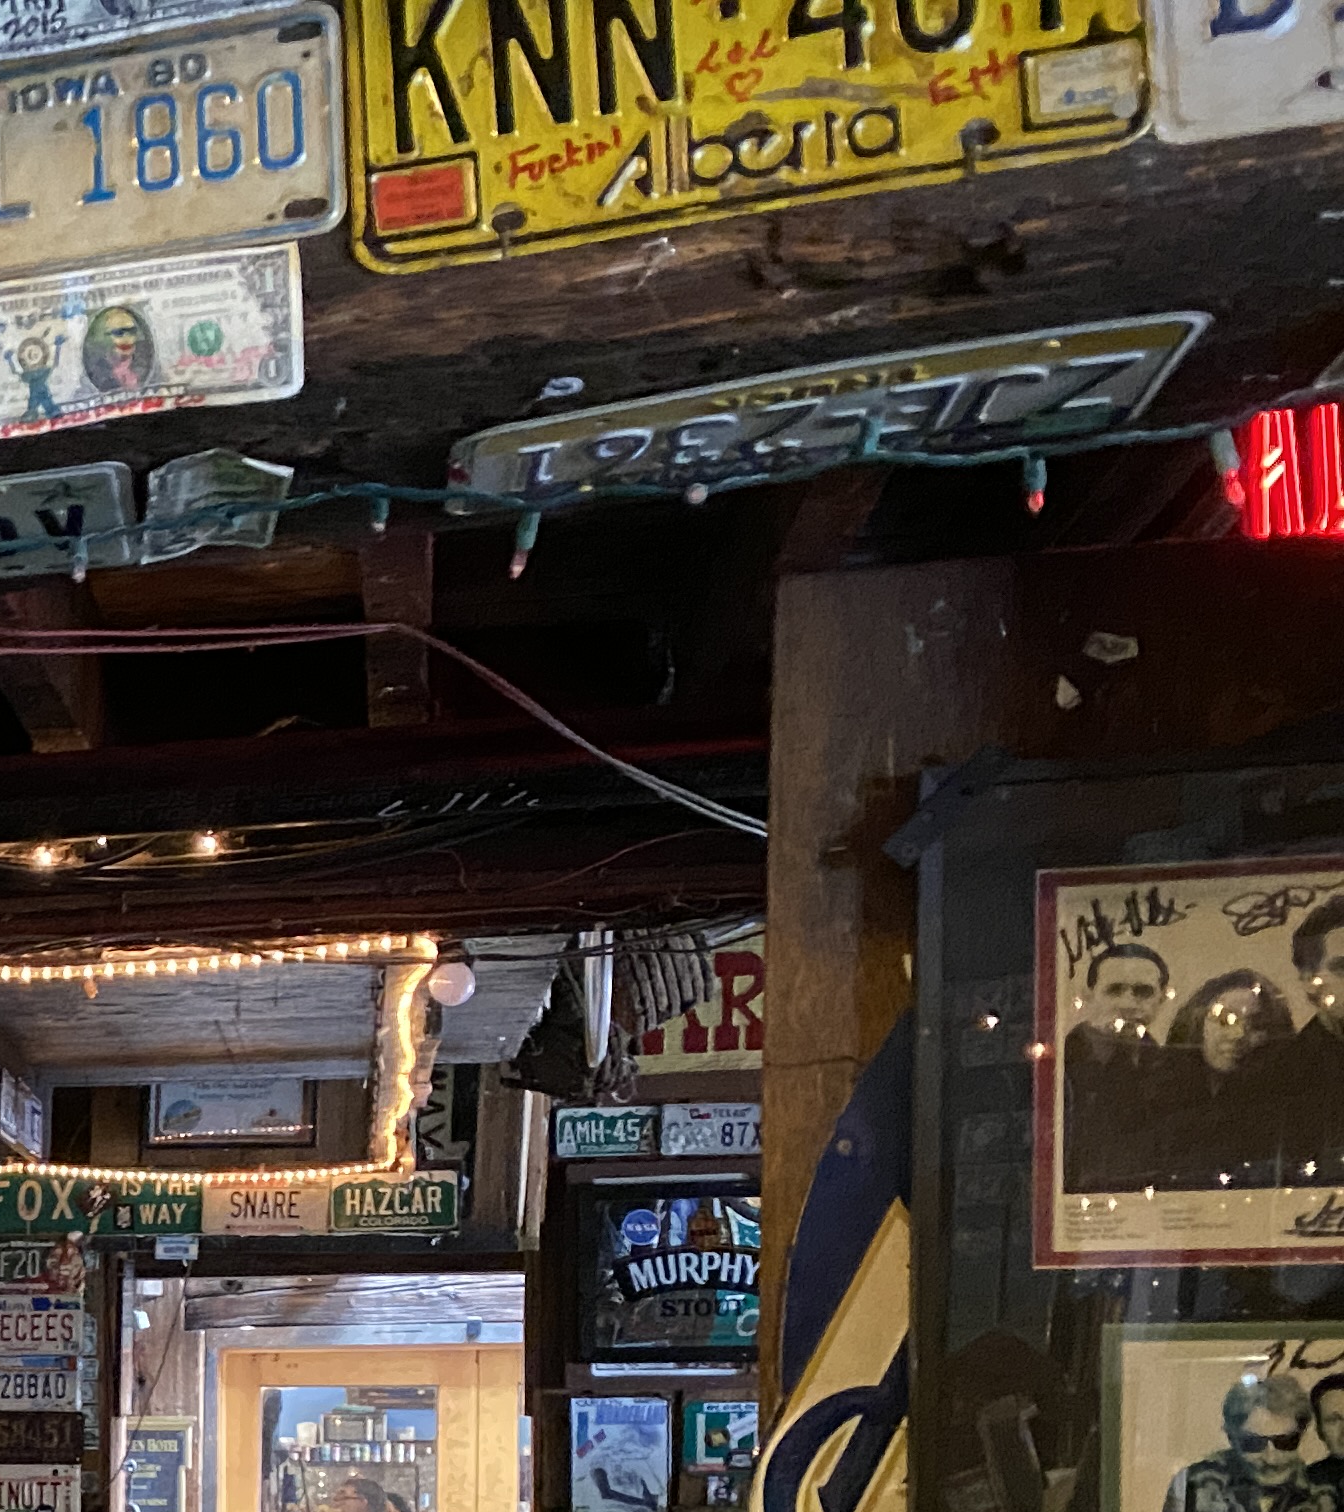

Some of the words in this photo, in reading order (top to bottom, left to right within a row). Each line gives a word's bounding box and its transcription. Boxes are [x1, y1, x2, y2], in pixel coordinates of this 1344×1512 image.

[8, 71, 120, 114] IOWA
[147, 53, 208, 87] 80
[388, 0, 679, 155] KNN
[82, 70, 306, 205] 1860
[154, 1175, 198, 1197] THE
[344, 1185, 443, 1217] HAZCAR
[140, 1203, 187, 1225] WAY
[230, 1190, 301, 1220] SNARE
[358, 1216, 430, 1227] COLORADO
[628, 1251, 761, 1293] MURPHY
[660, 1298, 745, 1318] STOUT
